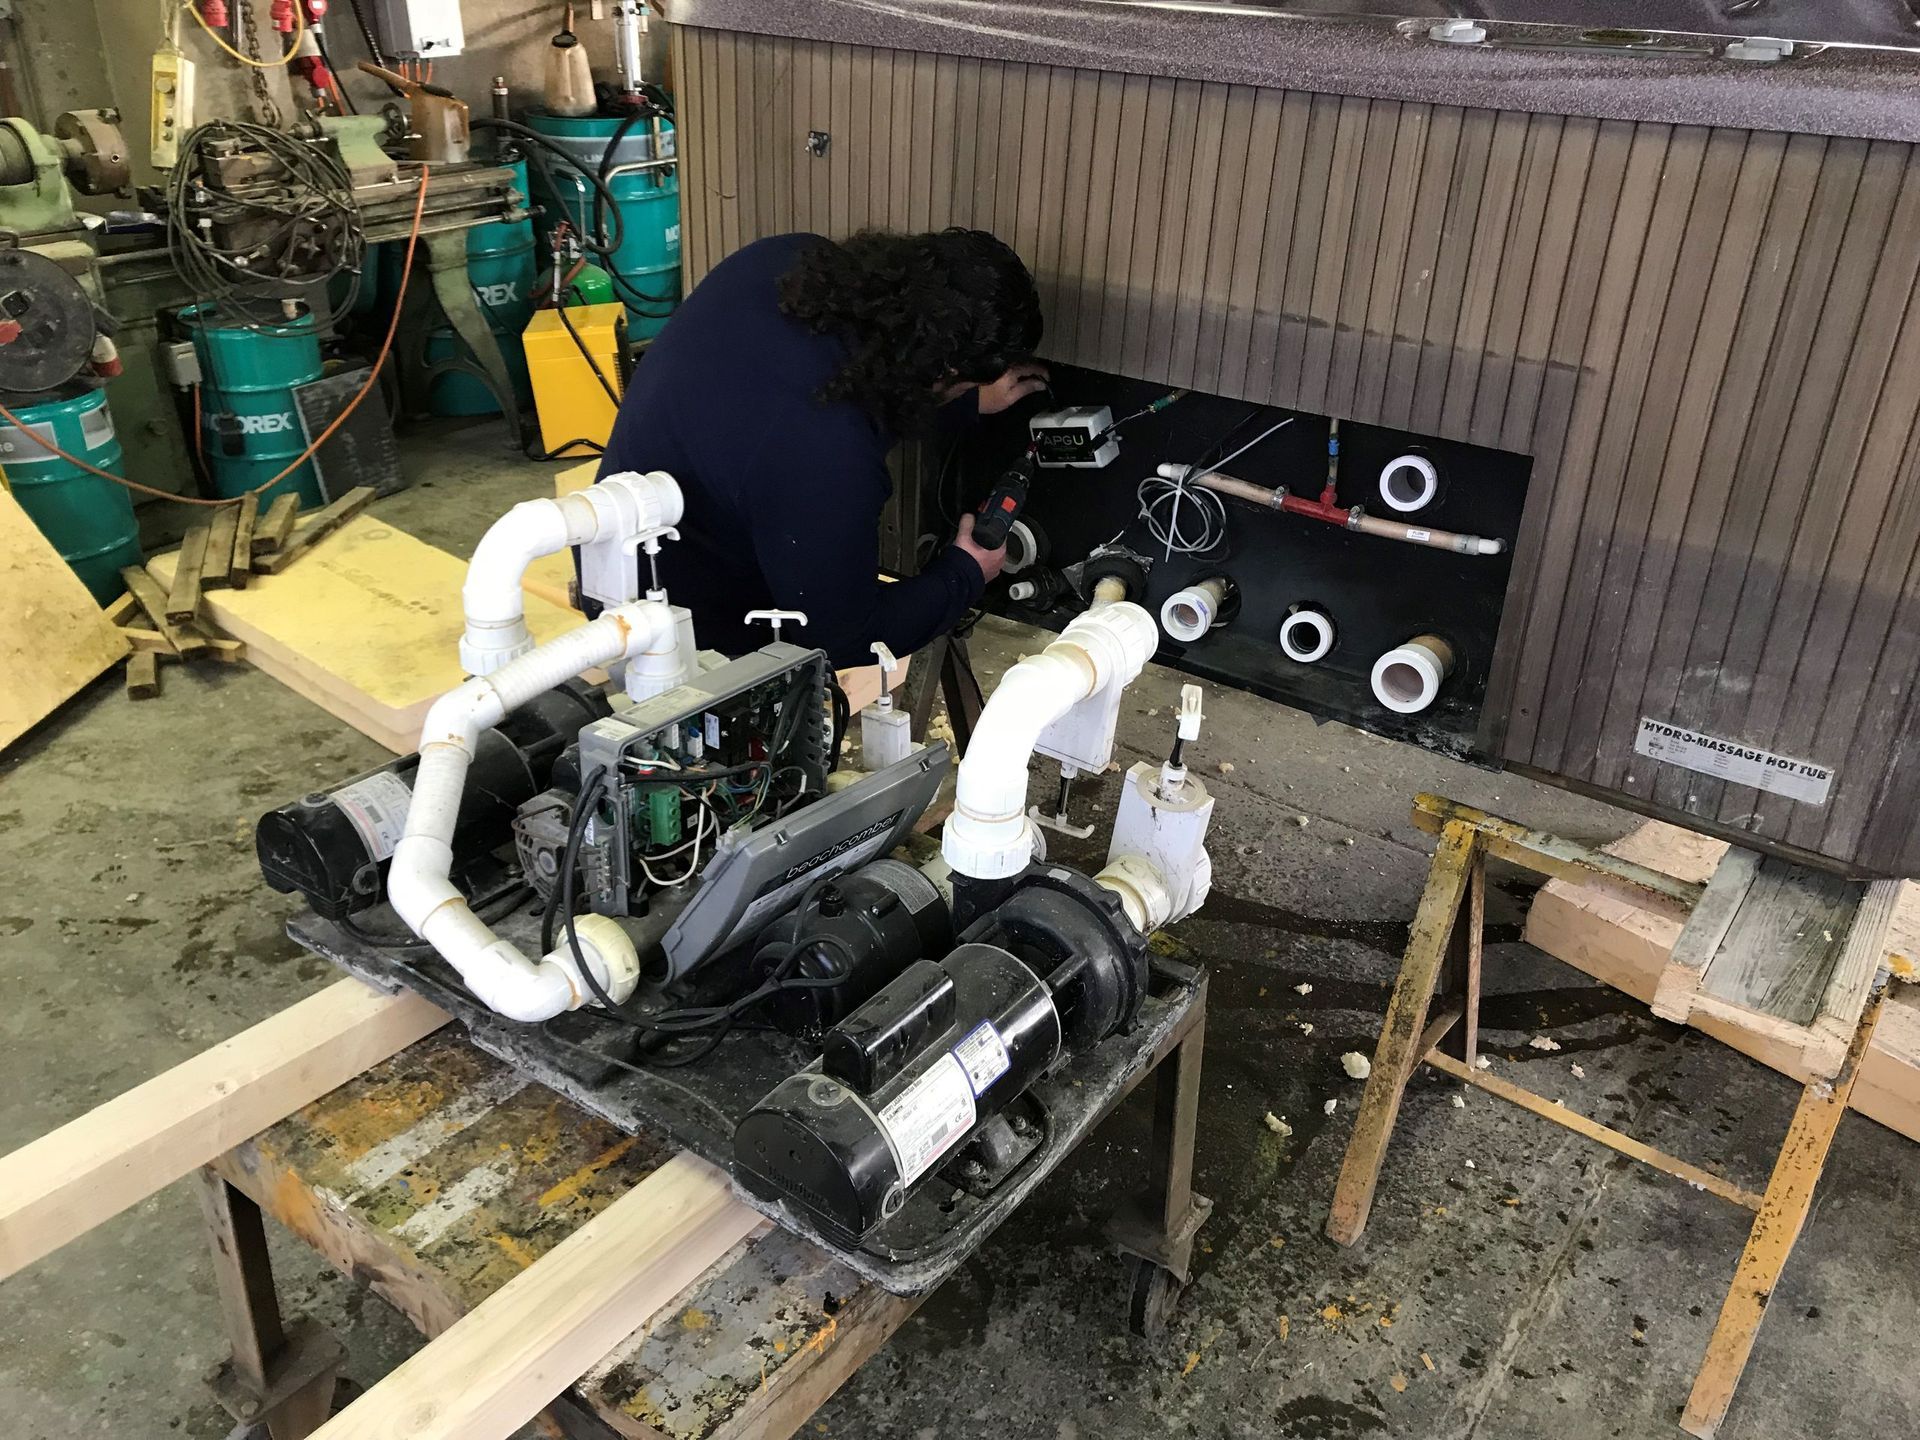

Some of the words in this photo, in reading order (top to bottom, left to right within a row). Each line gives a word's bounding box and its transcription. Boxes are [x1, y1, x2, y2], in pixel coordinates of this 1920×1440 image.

[1043, 434, 1084, 446] APGU
[1643, 721, 1764, 763] HYDRO-MASSAGE
[1765, 756, 1798, 772] HOT
[1799, 765, 1828, 780] TUB
[786, 814, 897, 879] beachcomber
